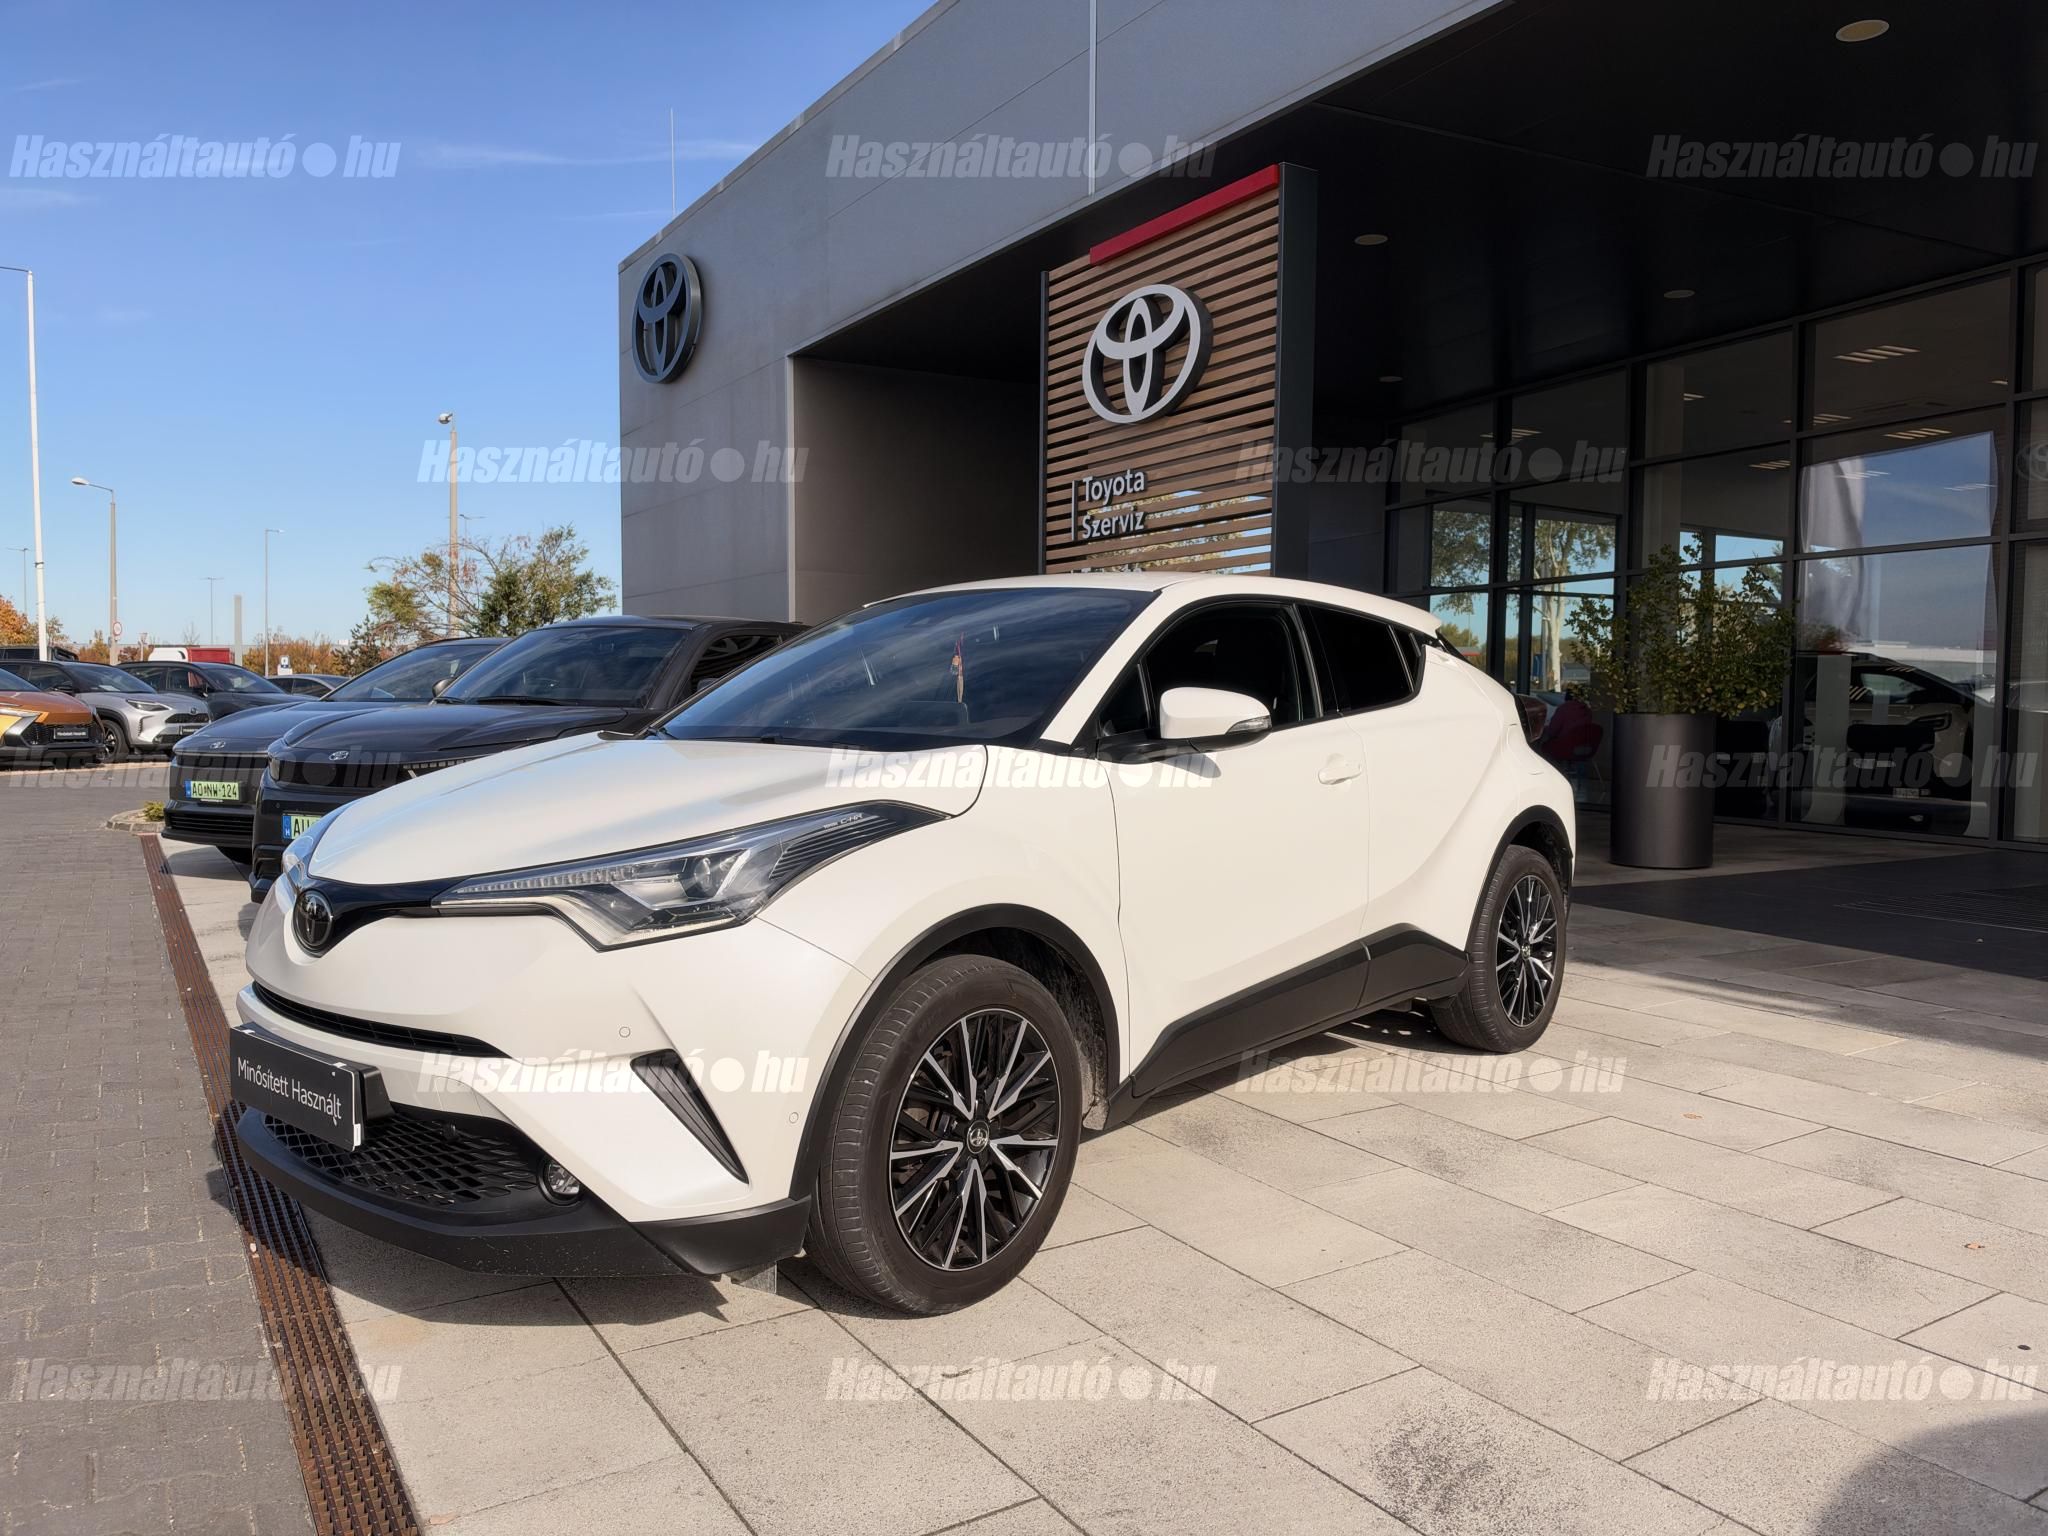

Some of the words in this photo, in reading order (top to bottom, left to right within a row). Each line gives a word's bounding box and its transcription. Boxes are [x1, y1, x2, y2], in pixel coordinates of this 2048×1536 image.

[1082, 469, 1145, 505] Toyota
[1082, 507, 1145, 539] Szerviz
[237, 1057, 289, 1098] Minősített
[291, 1078, 342, 1120] Használt
